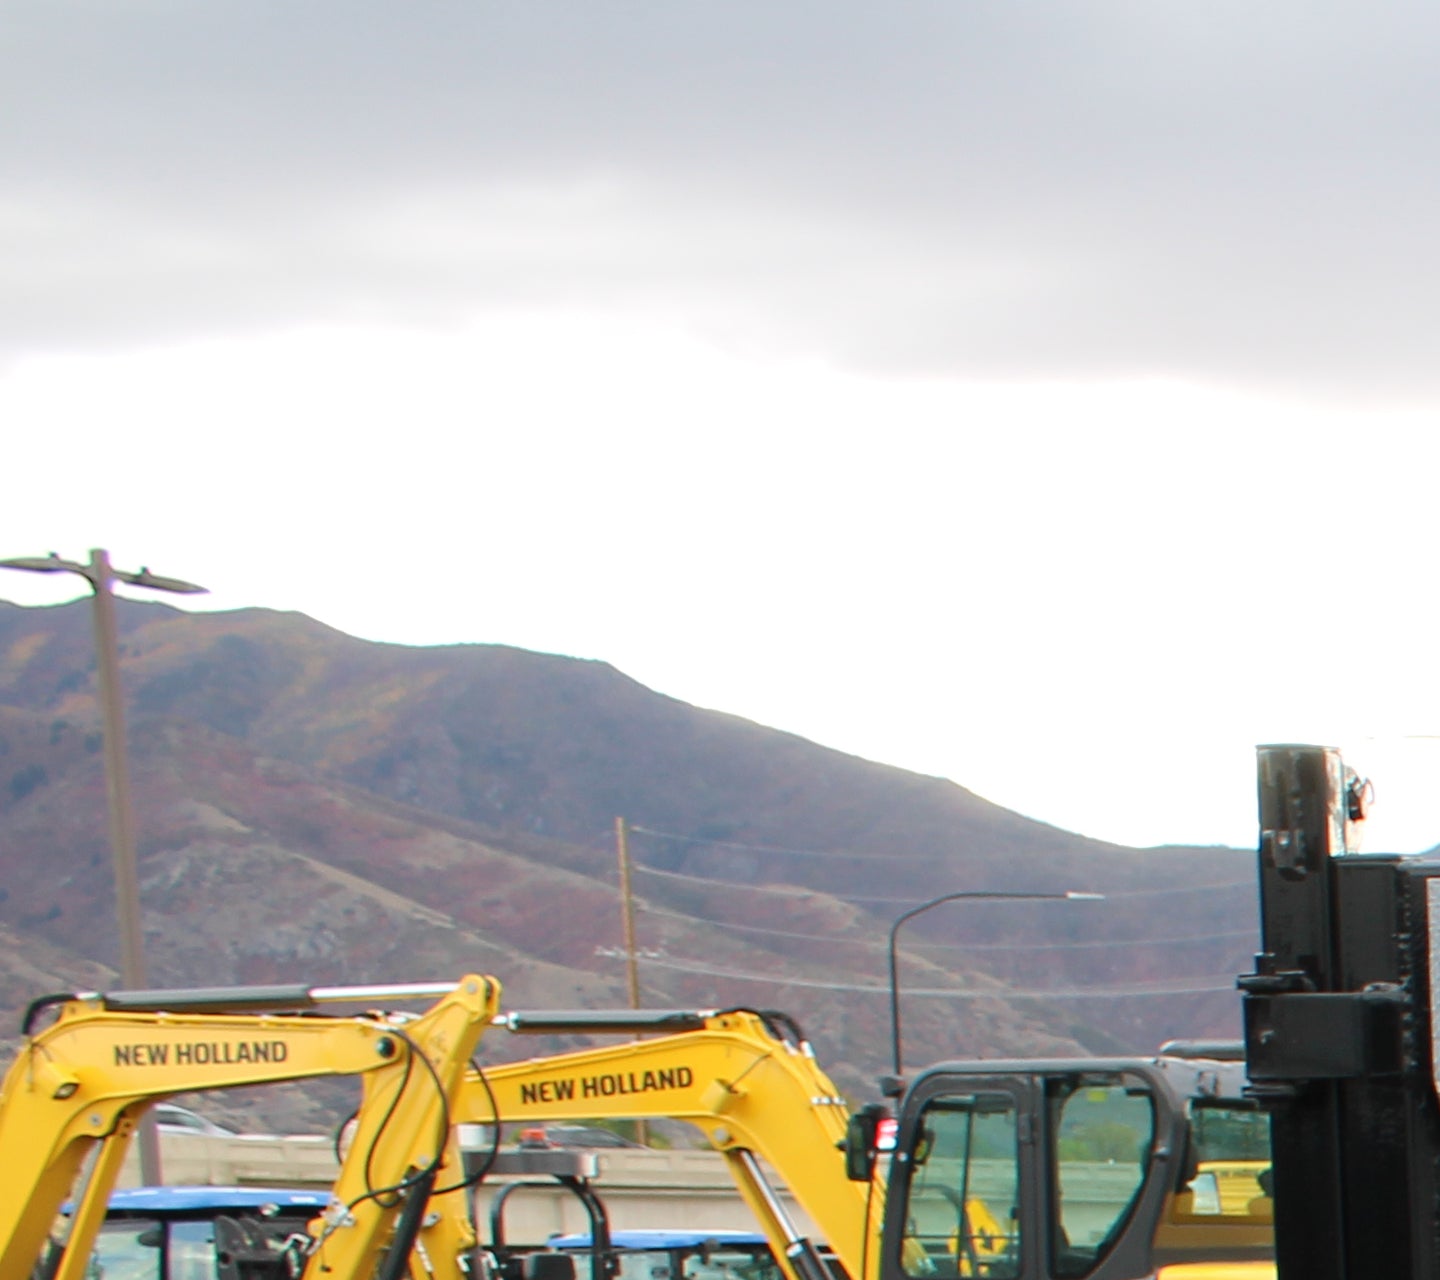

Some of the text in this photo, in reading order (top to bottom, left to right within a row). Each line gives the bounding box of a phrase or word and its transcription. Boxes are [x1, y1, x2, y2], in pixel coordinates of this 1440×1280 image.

[114, 1041, 288, 1066] NEW HOLLAND
[520, 1066, 694, 1104] NEW HOLLAND
